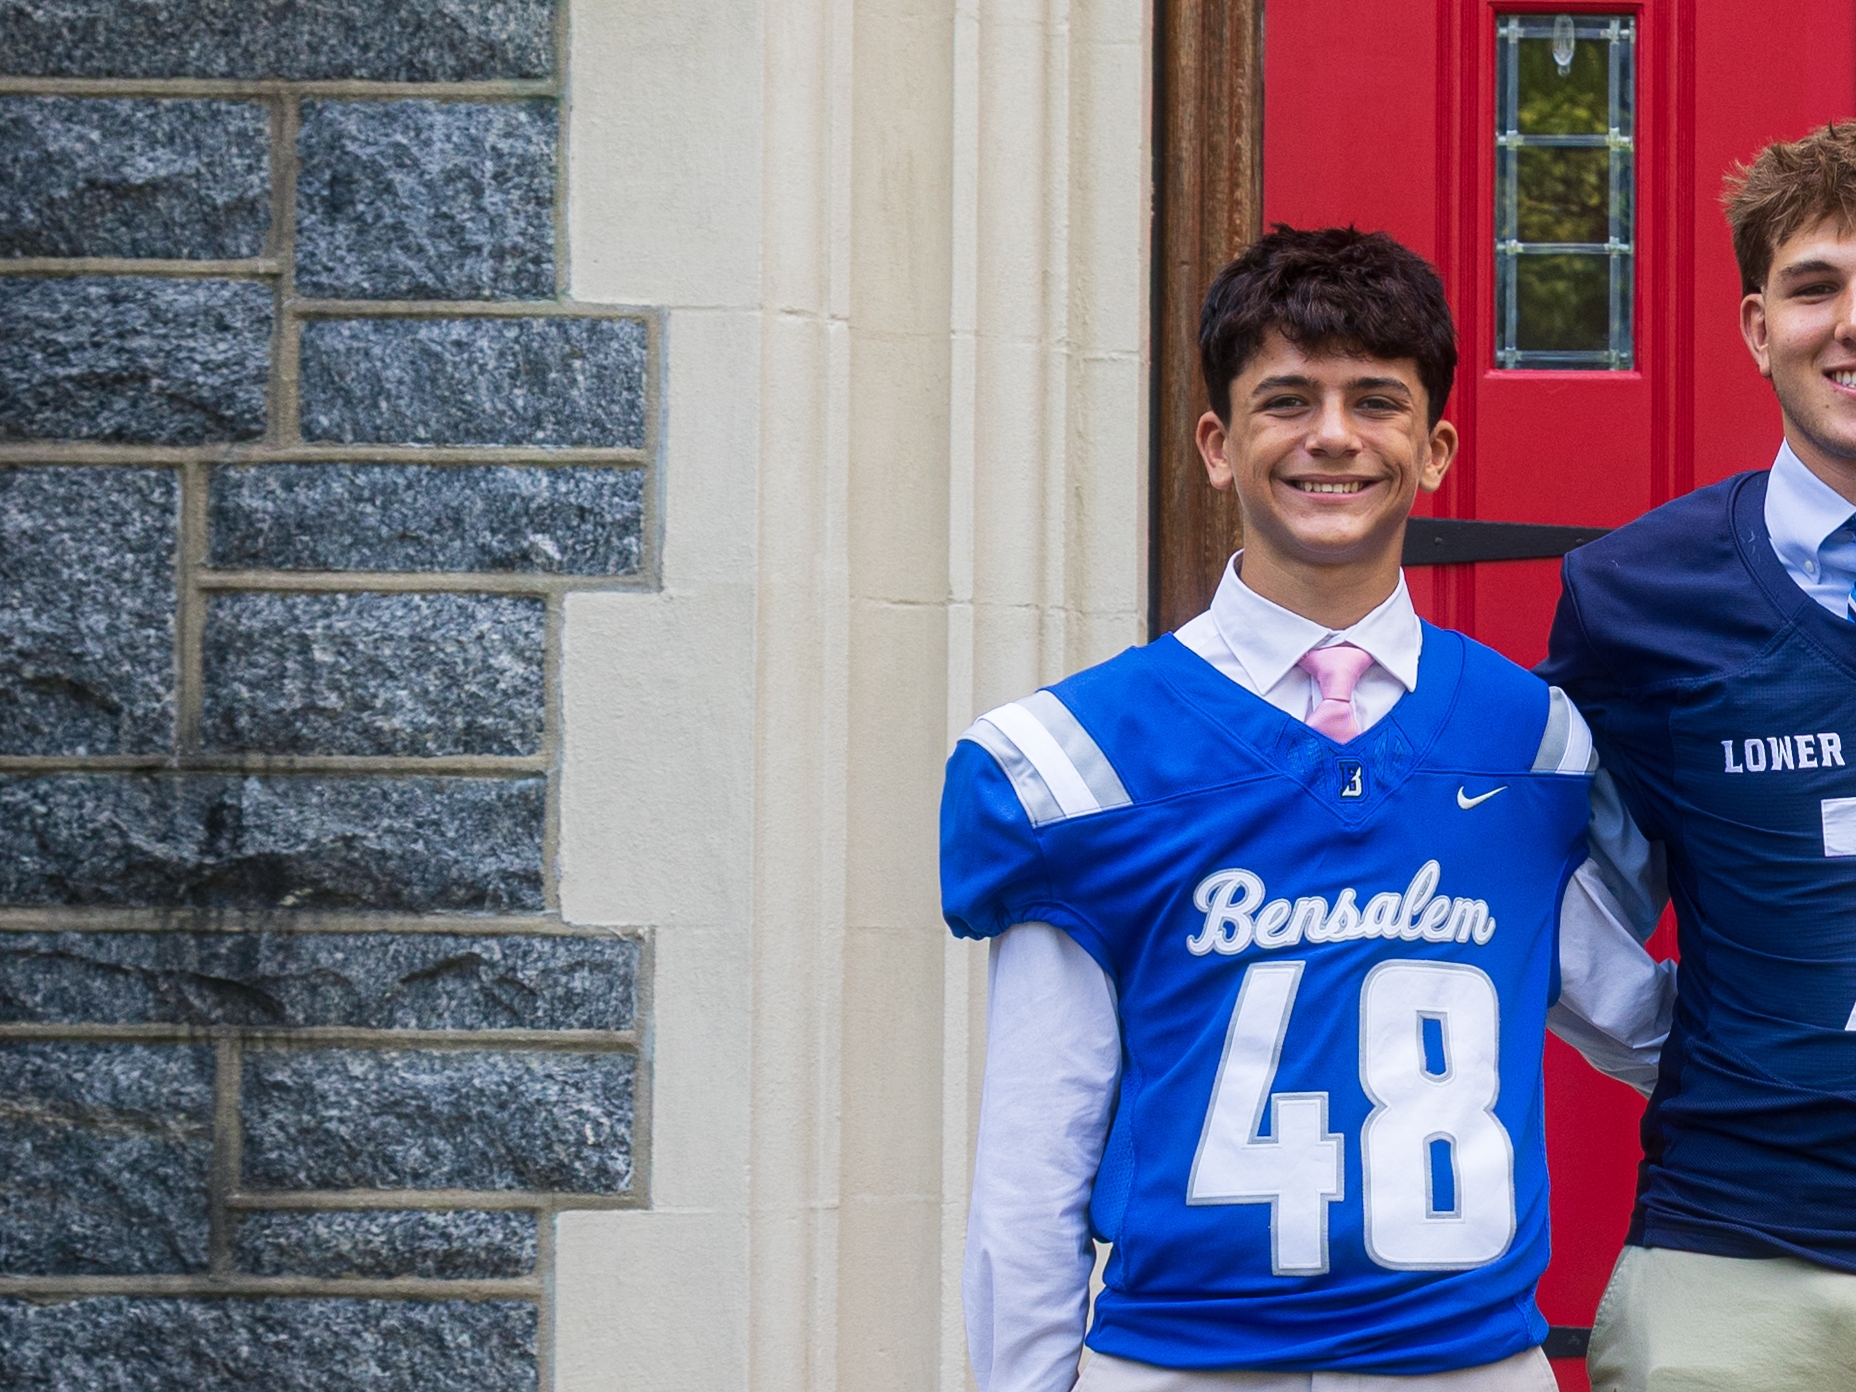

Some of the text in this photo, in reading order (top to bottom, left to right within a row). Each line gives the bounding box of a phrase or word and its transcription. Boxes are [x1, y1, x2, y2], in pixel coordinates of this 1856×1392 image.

[1721, 732, 1846, 773] LOWER
[1186, 859, 1497, 957] Bensalem
[1186, 958, 1517, 1276] 48
